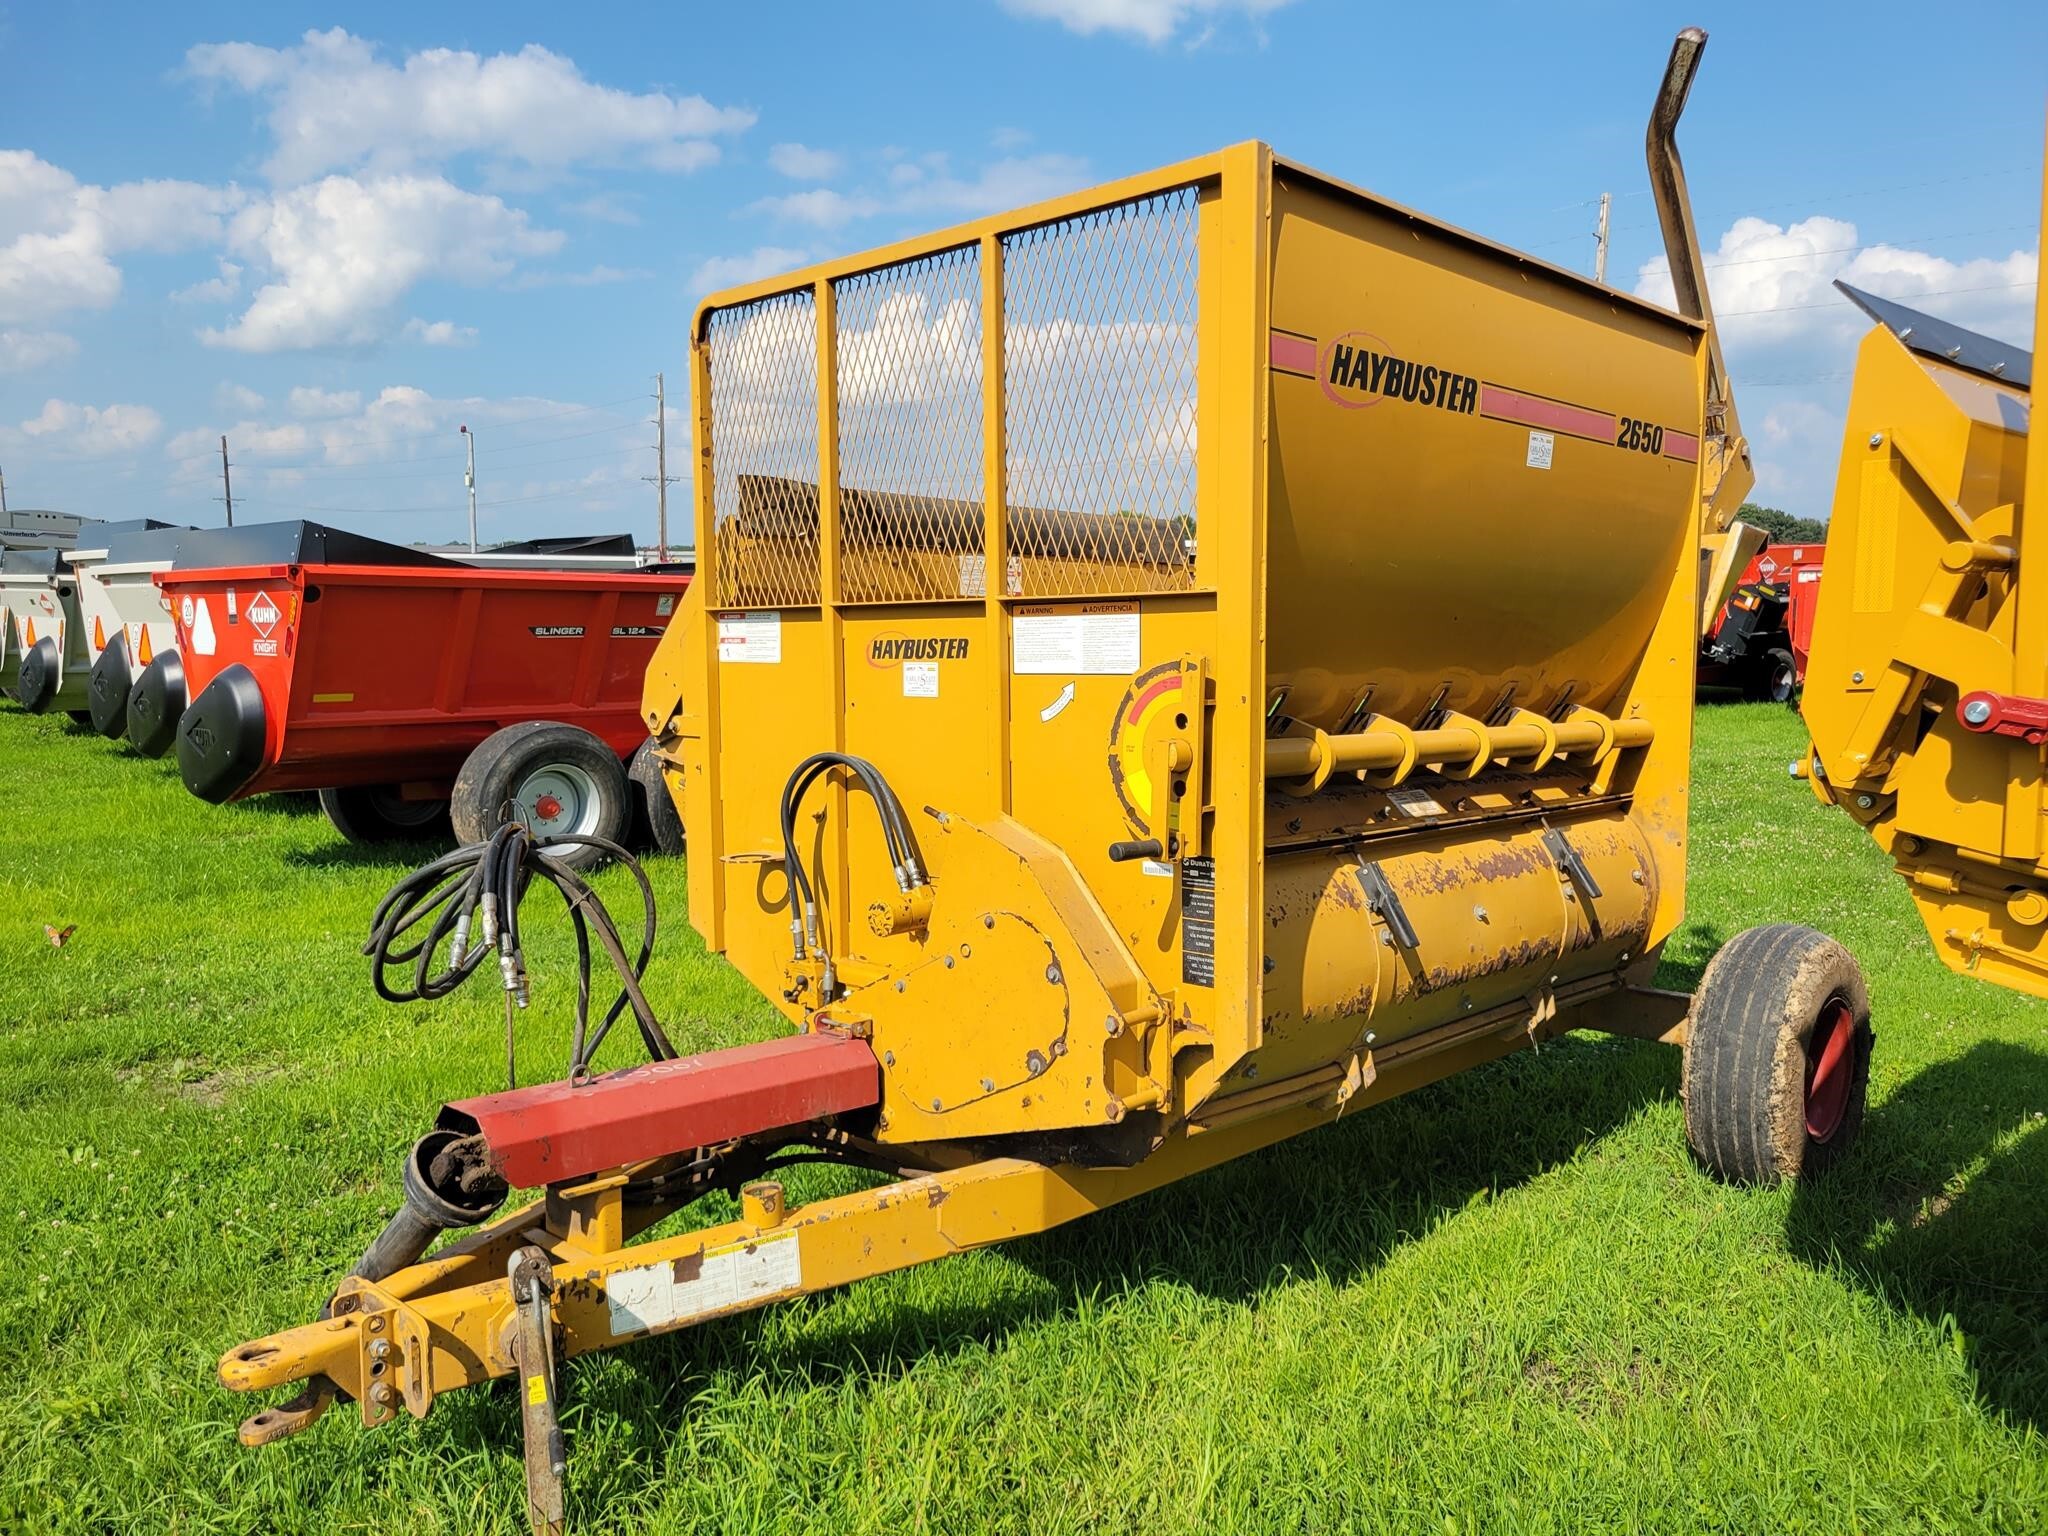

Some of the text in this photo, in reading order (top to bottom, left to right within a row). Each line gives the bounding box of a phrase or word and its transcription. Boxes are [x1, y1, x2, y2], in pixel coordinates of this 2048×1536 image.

[1330, 344, 1478, 416] HAYBUSTER
[1616, 417, 1664, 455] 2650
[1025, 607, 1054, 615] WARNING
[1088, 604, 1133, 613] ADVERTENCIA
[251, 607, 276, 623] KUHN
[535, 627, 583, 635] SLINGER
[612, 627, 646, 635] SL 124
[253, 643, 277, 653] KNIGHT
[871, 637, 969, 660] HAYBUSTER
